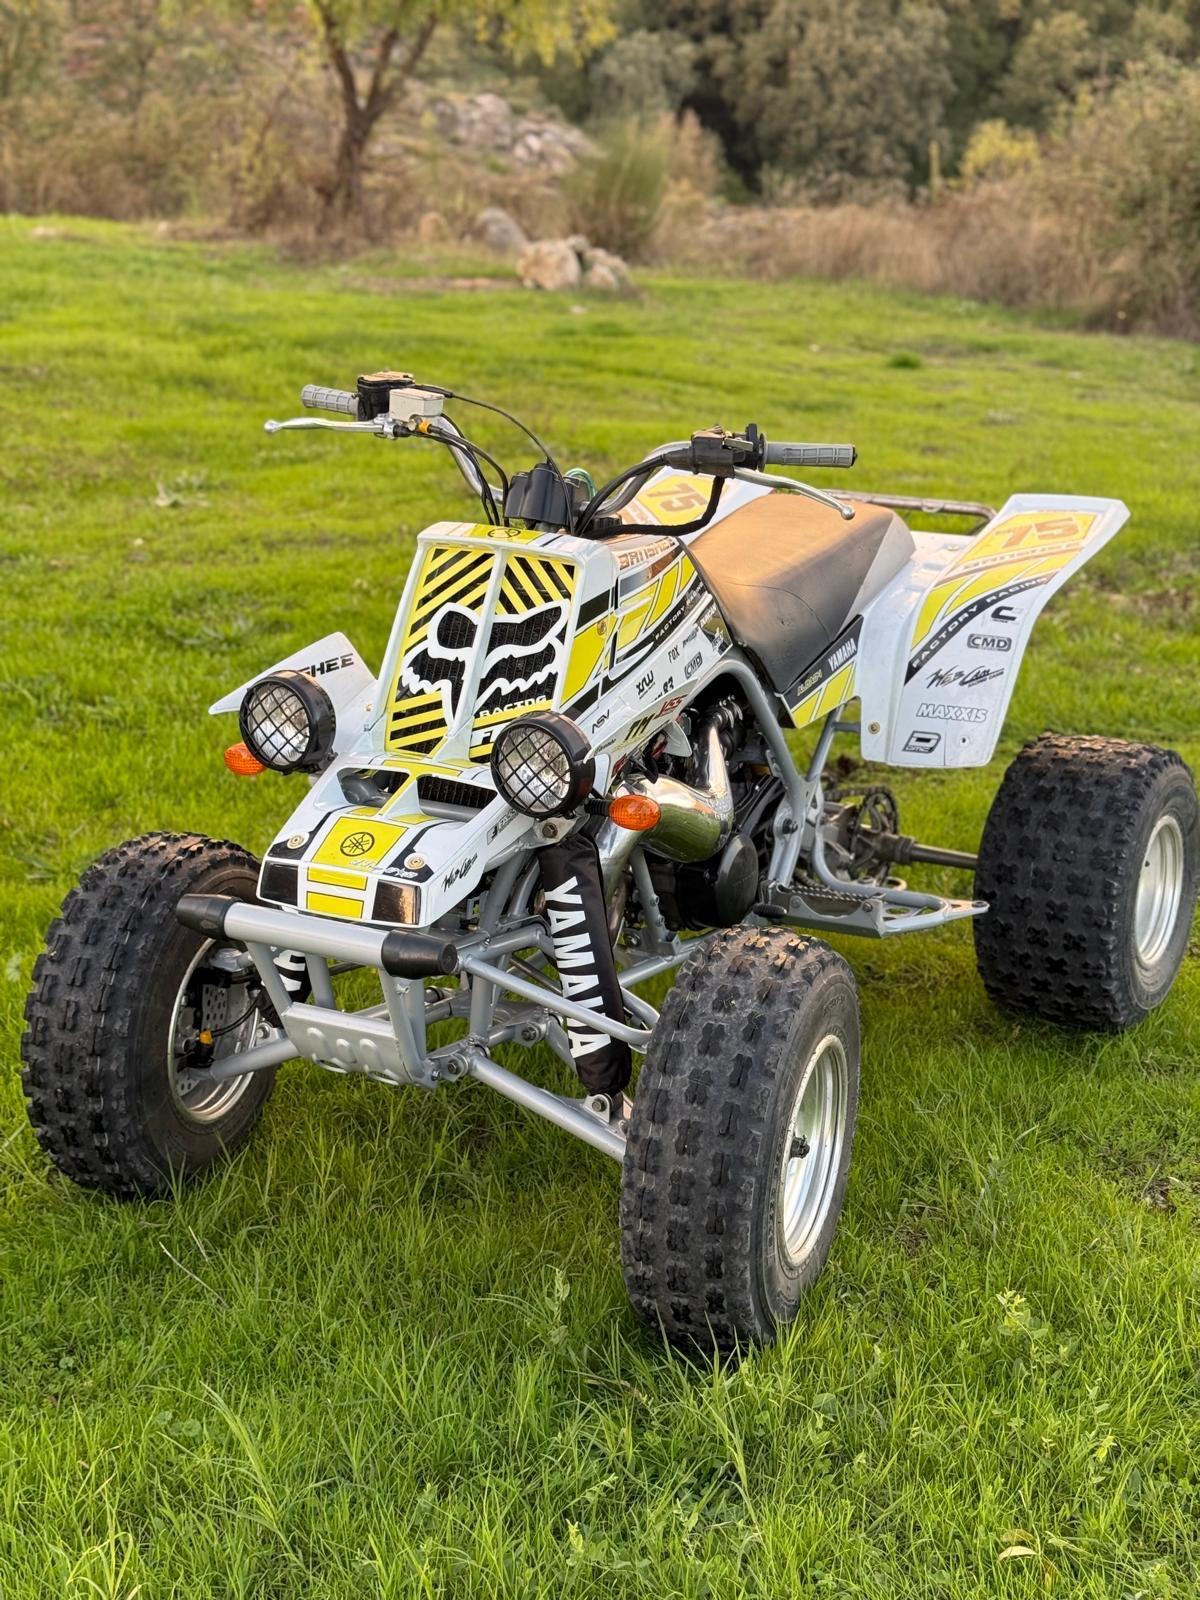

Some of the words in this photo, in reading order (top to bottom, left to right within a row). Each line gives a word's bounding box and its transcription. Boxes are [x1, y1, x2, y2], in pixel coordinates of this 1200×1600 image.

[994, 517, 1079, 549] 75
[655, 605, 686, 640] FACTORY
[911, 605, 979, 668] FACTORY
[985, 577, 1048, 603] RACING
[668, 645, 680, 664] FOX
[828, 638, 857, 672] YAMAHA
[968, 634, 1011, 651] CMD
[684, 653, 703, 679] CMD
[592, 709, 610, 734] ASV
[916, 703, 989, 723] MAXXIS
